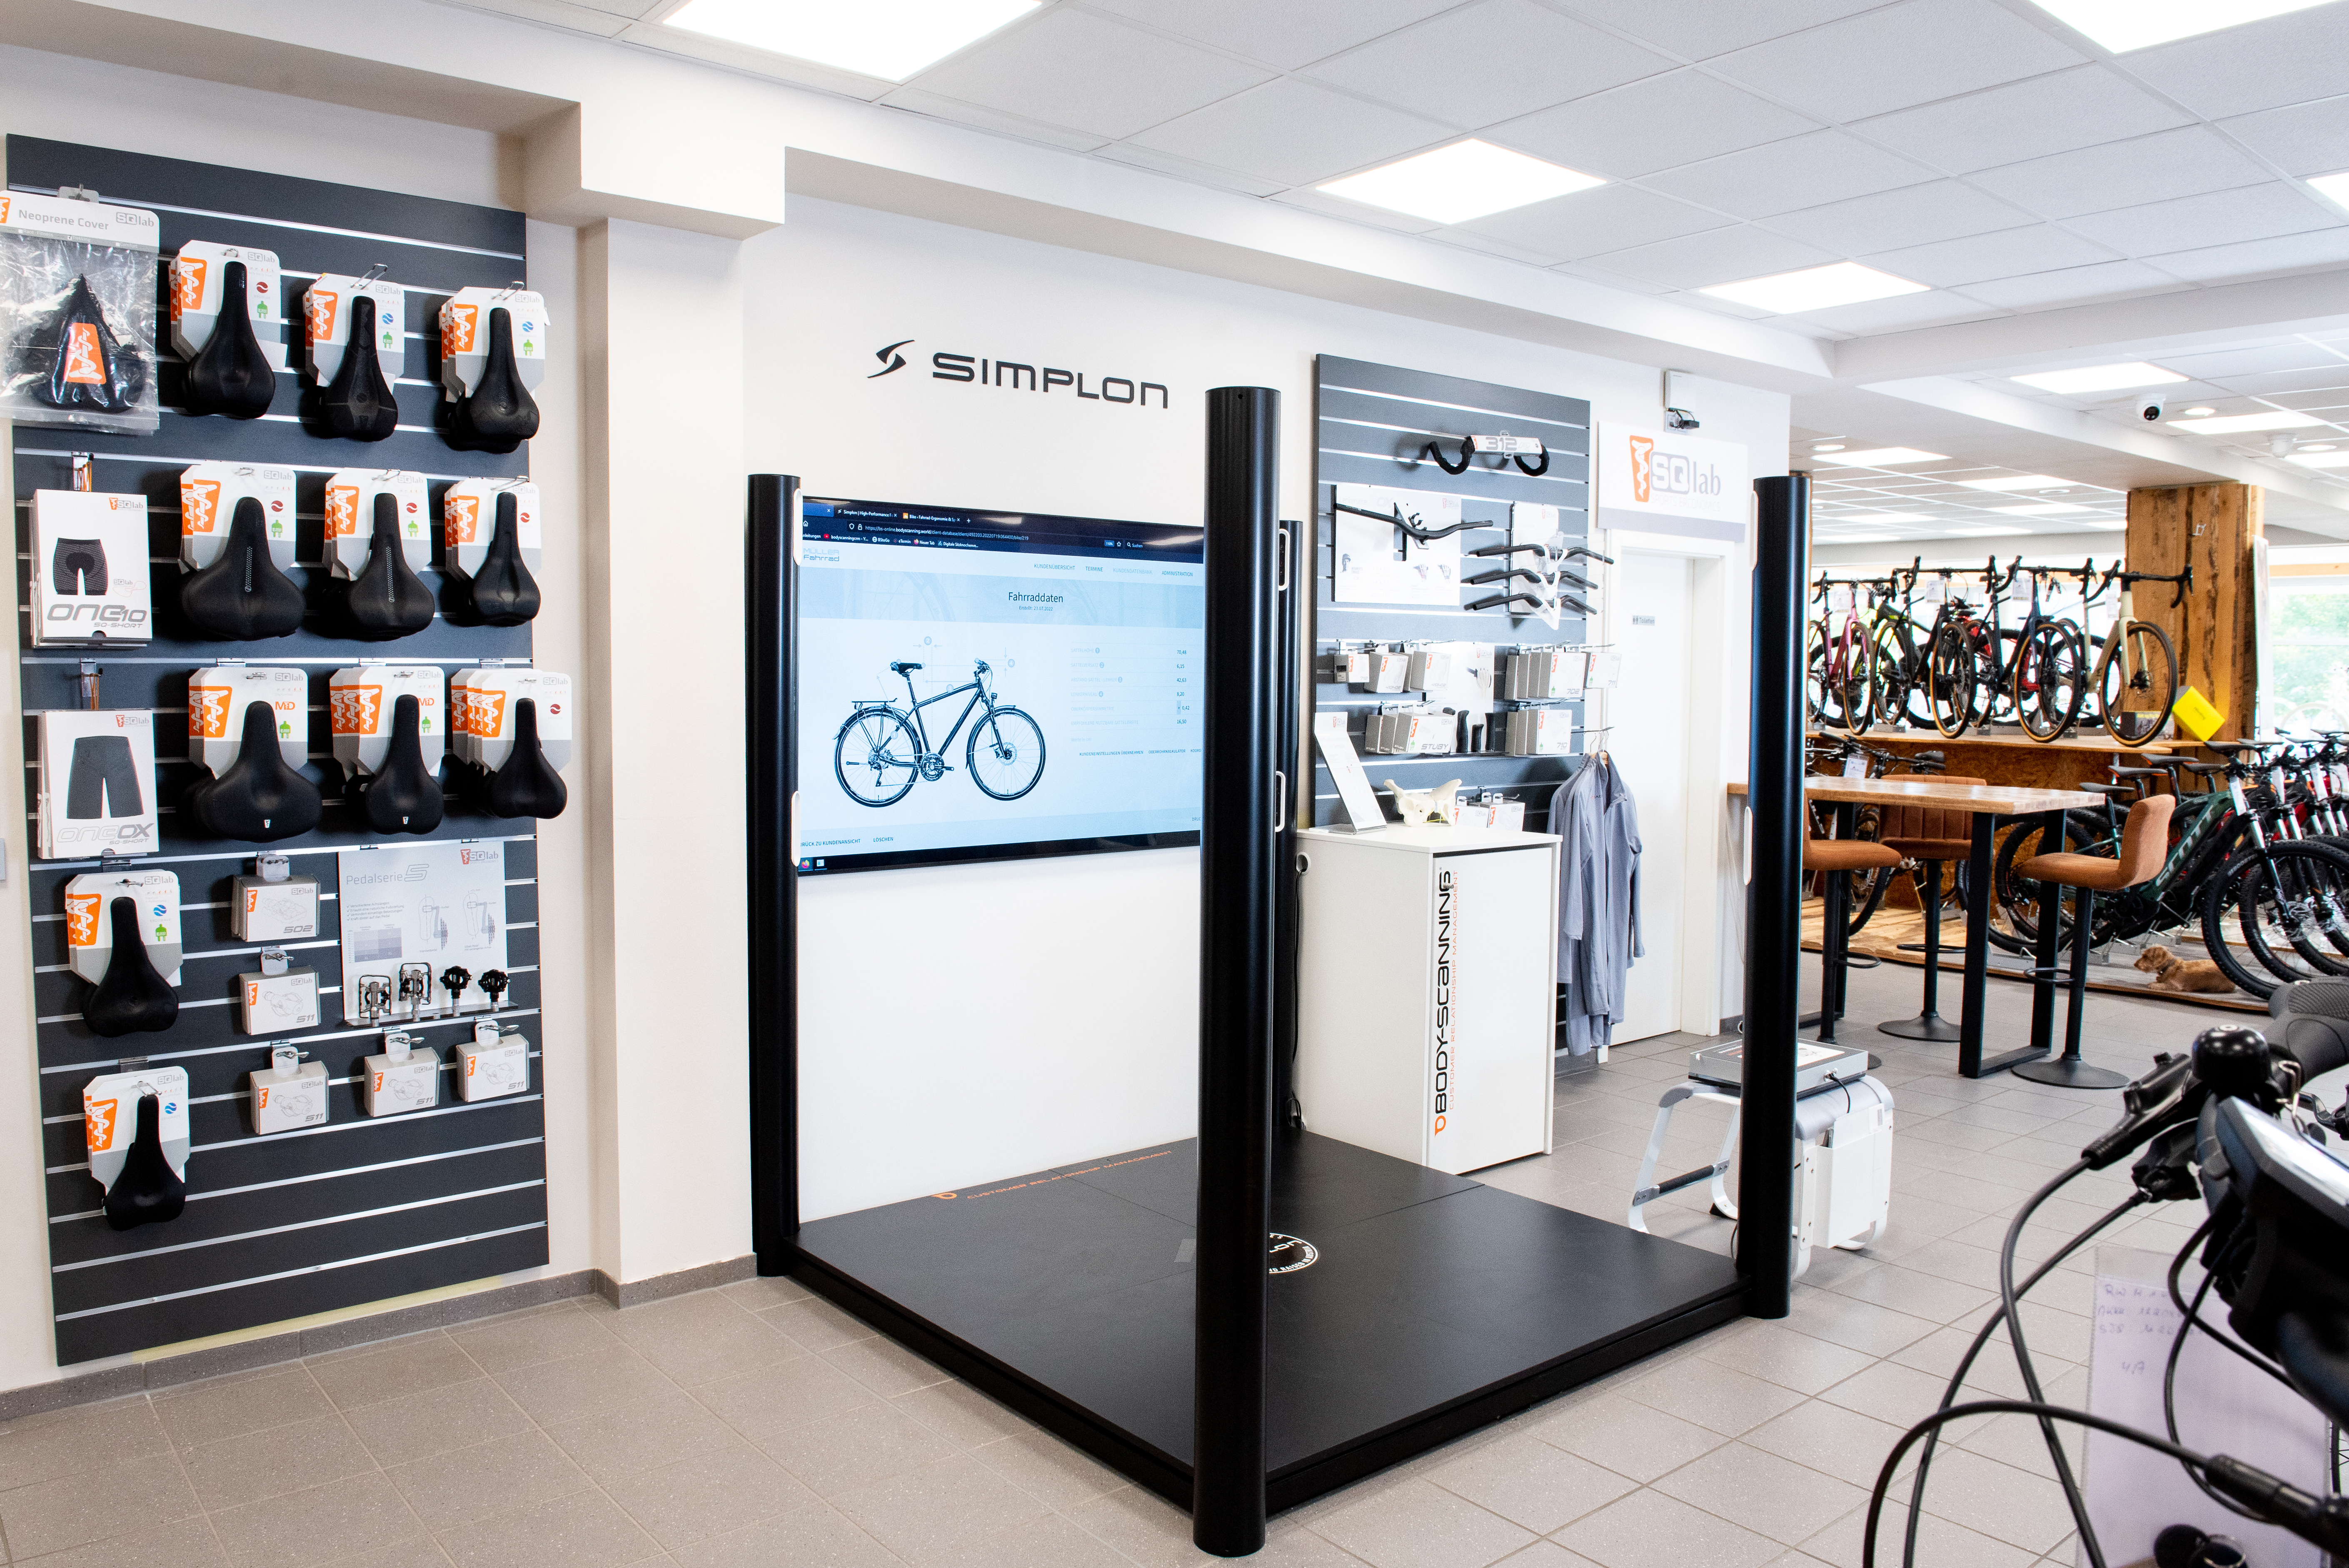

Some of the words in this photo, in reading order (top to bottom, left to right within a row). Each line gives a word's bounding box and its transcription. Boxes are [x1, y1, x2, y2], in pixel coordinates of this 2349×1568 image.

[19, 209, 75, 225] Neoprene
[77, 217, 109, 230] Cover
[932, 352, 1168, 409] SIMPLON
[1485, 437, 1517, 450] 312
[1650, 451, 1721, 496] SQlab
[1008, 592, 1063, 603] Fahrraddaten
[346, 872, 403, 885] Pedalserie
[1280, 1261, 1306, 1271] RAISED
